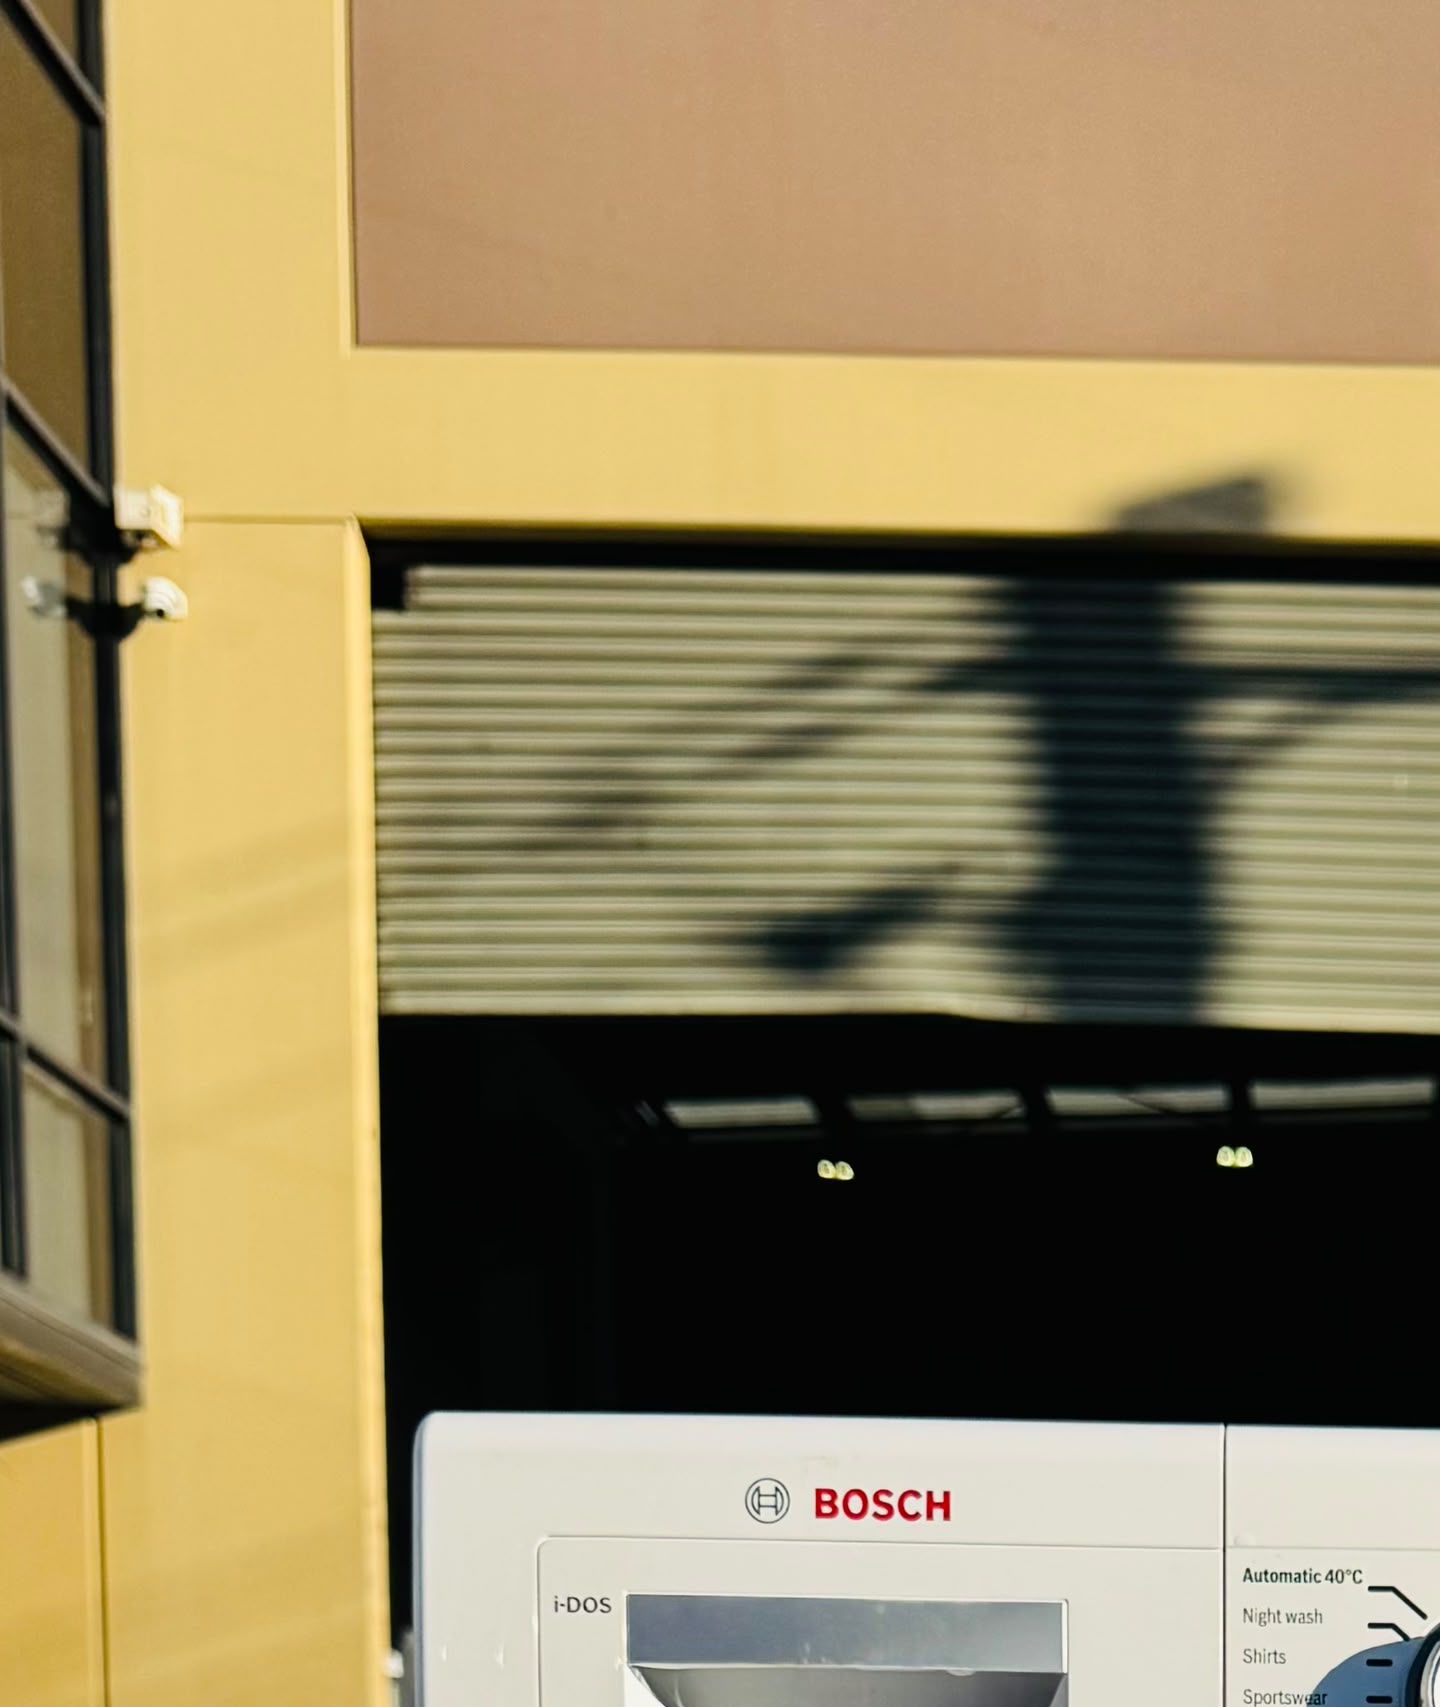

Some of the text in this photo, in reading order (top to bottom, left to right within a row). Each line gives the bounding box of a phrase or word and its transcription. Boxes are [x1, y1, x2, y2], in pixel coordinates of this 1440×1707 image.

[814, 1487, 952, 1522] BOSCH
[1242, 1567, 1364, 1585] Automatic 40°C
[552, 1595, 612, 1615] i-DOS
[1242, 1608, 1323, 1627] Night wash
[1242, 1648, 1287, 1665] Shirts
[1242, 1689, 1328, 1707] Sportswear
